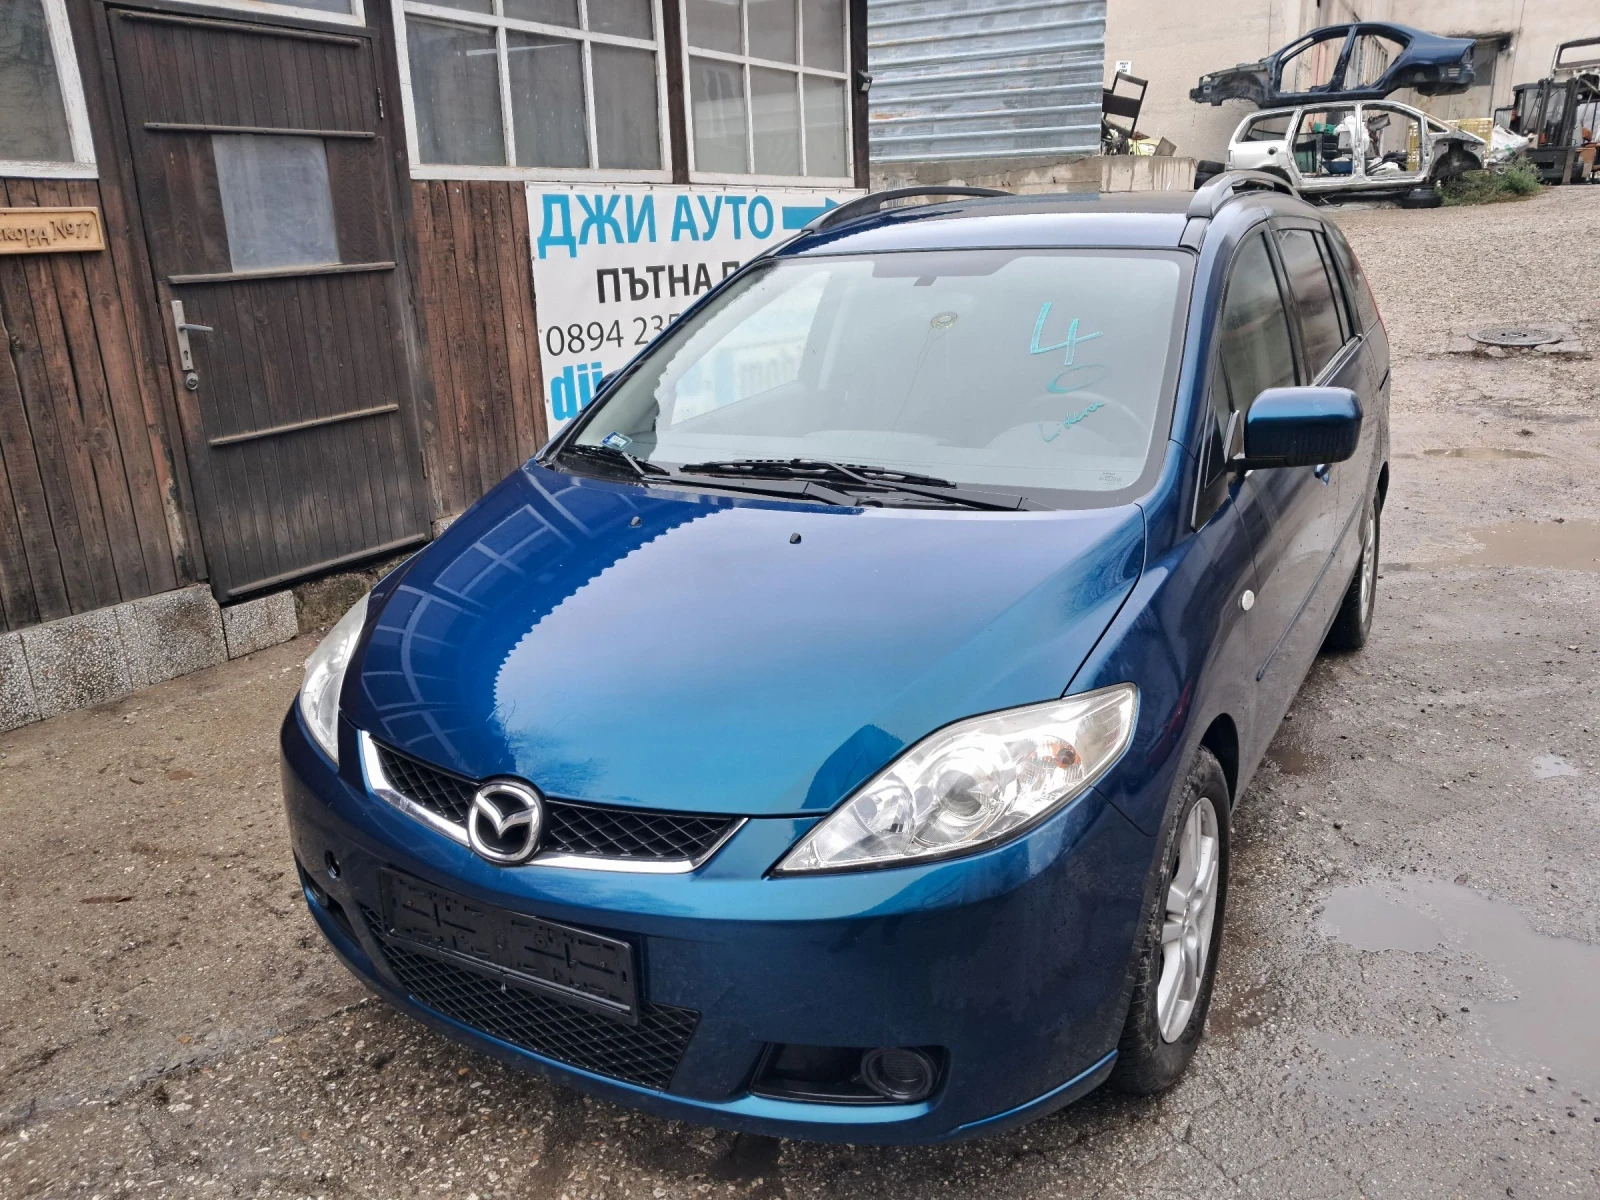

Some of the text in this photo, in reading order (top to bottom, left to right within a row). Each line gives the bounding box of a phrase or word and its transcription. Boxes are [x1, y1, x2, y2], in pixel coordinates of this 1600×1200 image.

[0, 226, 51, 249] корд
[537, 193, 775, 260] ДЖИ АУТО
[596, 262, 714, 304] ПЪТНА
[546, 319, 625, 357] 0894
